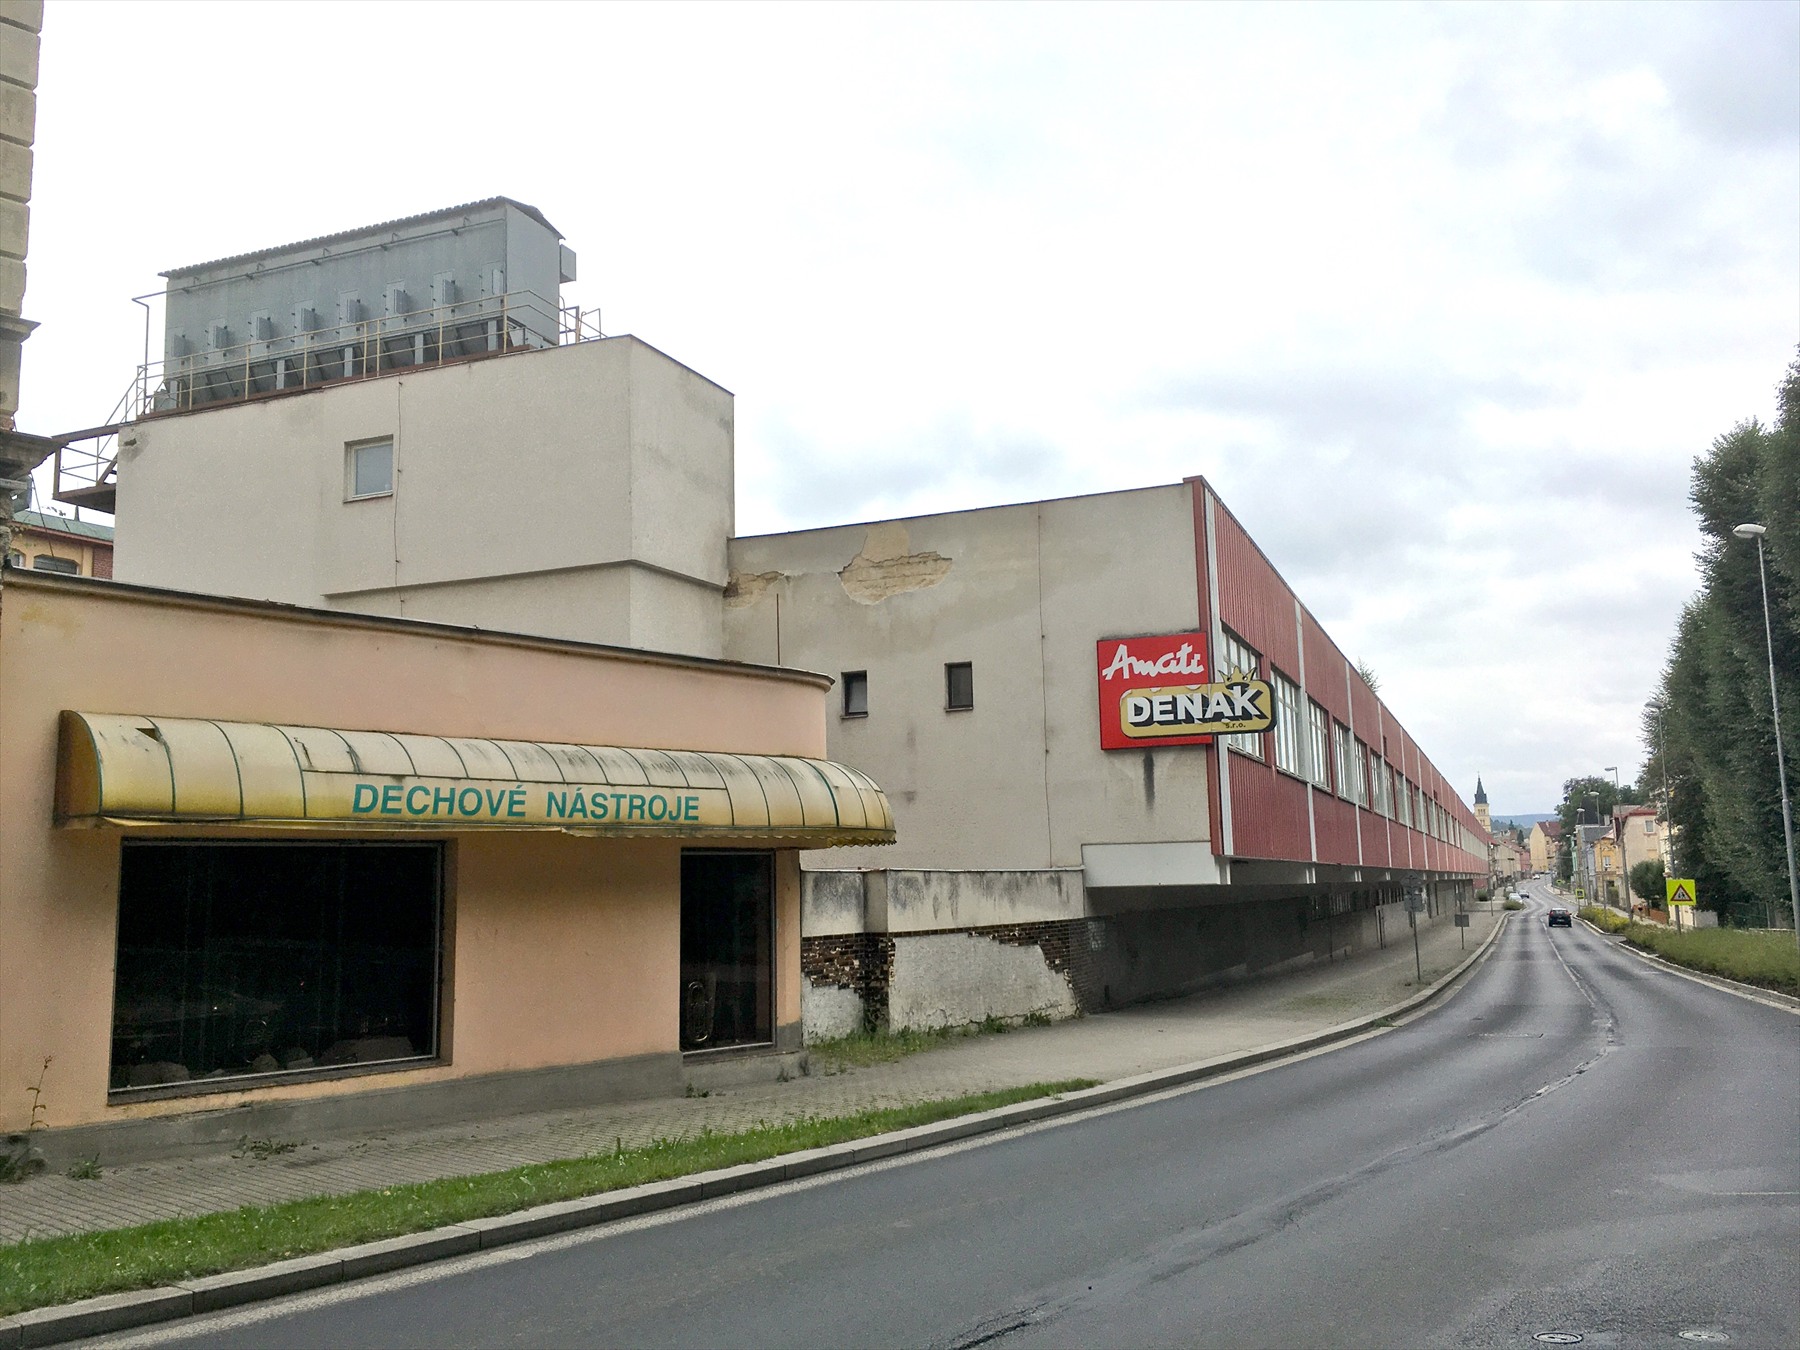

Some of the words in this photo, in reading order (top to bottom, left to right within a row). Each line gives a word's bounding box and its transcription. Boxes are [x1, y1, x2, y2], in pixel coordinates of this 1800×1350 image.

[1102, 642, 1204, 680] Amati
[1127, 686, 1266, 726] DENAK
[352, 783, 527, 818] DECHOVÉ
[546, 787, 700, 821] NÁSTROJE
